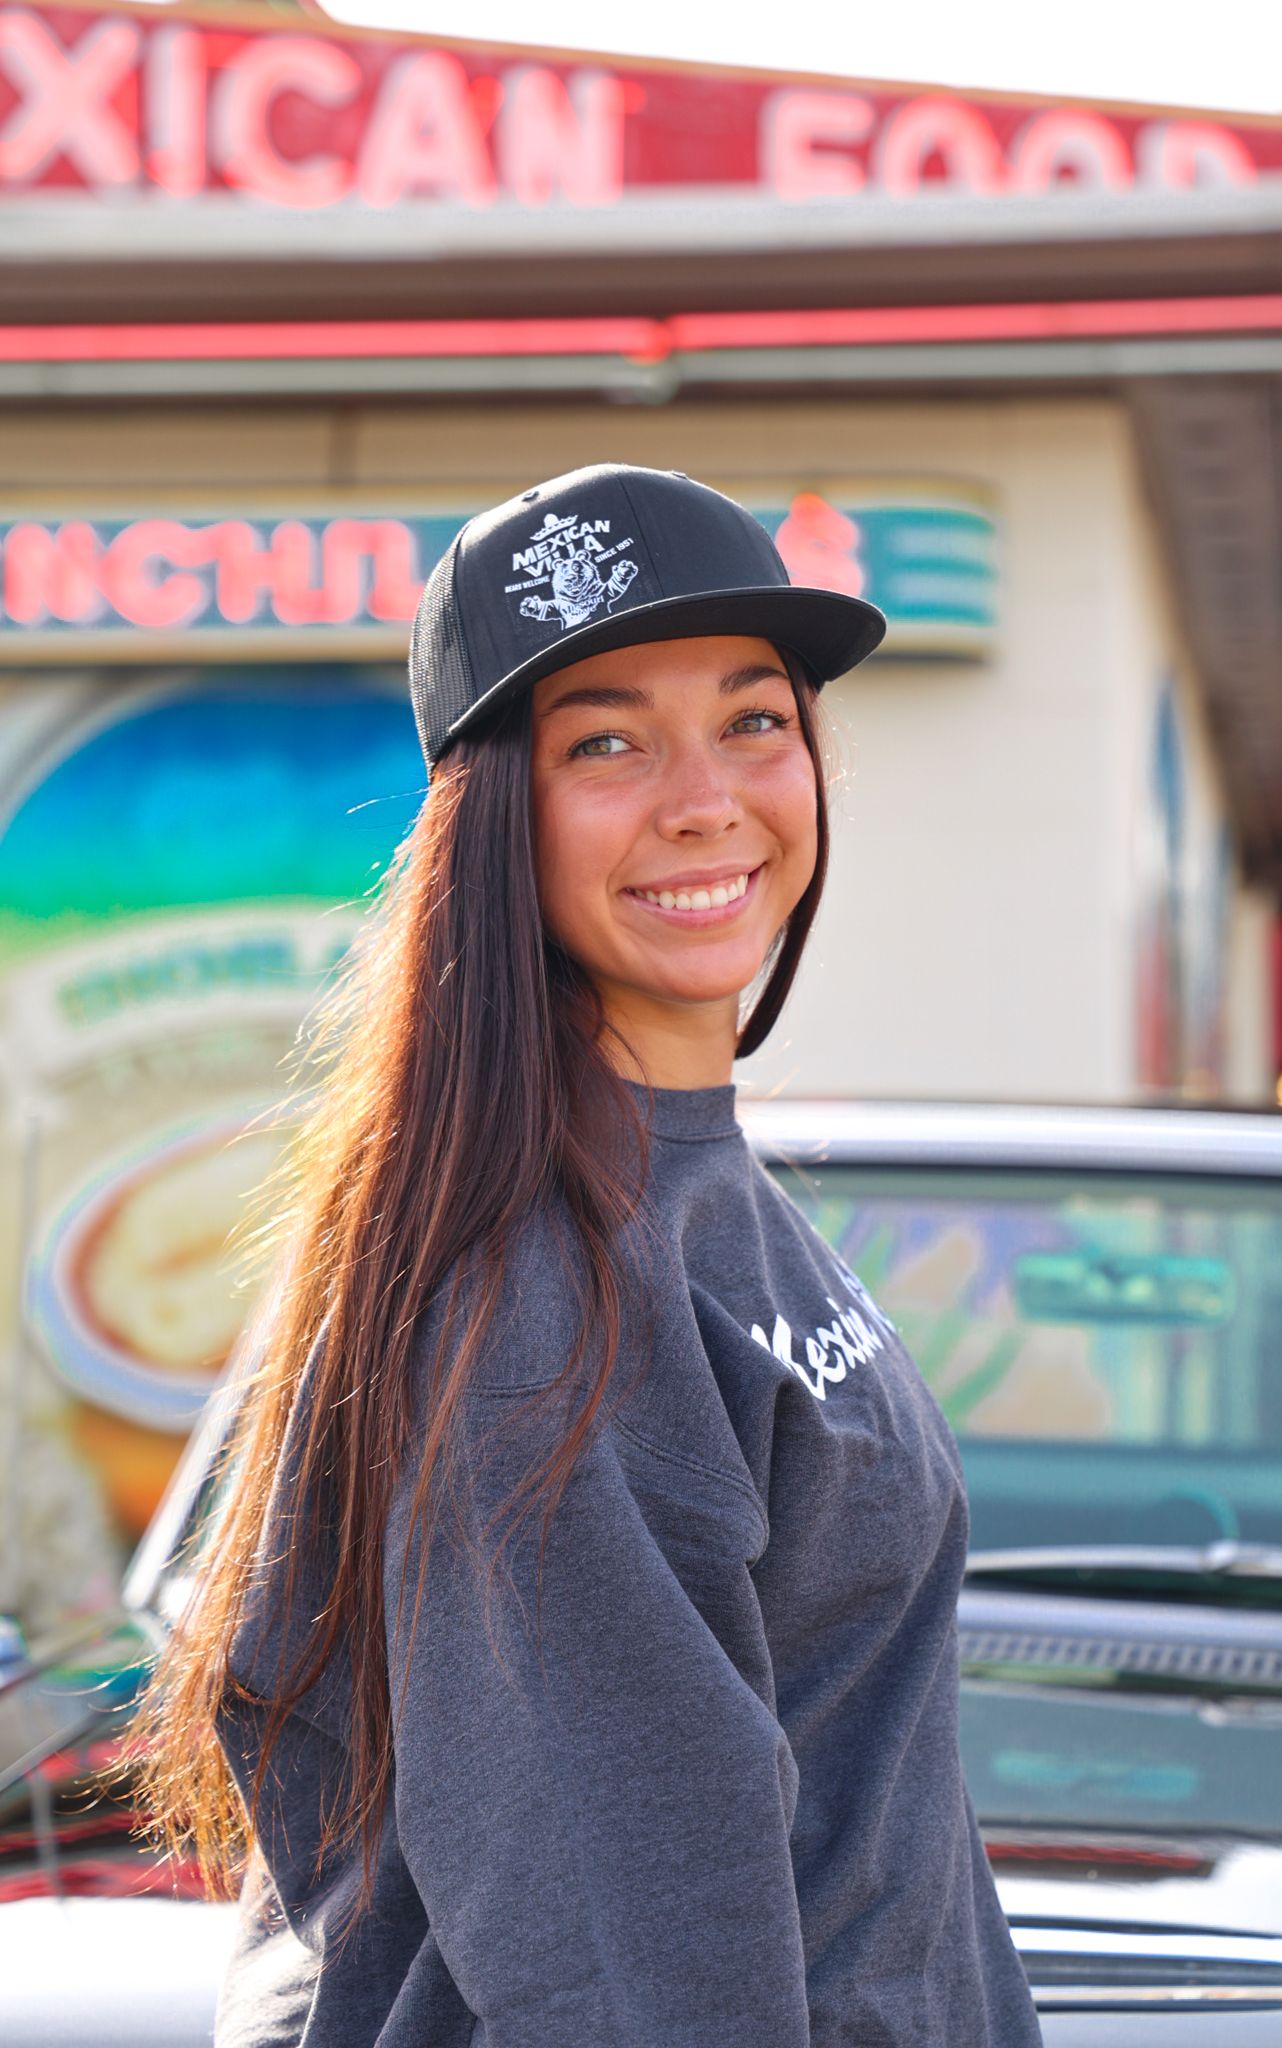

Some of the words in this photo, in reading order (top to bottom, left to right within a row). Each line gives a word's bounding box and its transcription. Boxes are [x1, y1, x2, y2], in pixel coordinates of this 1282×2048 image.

[512, 520, 611, 571] MEXICAN
[594, 547, 617, 563] SINCE
[615, 537, 634, 552] 1951
